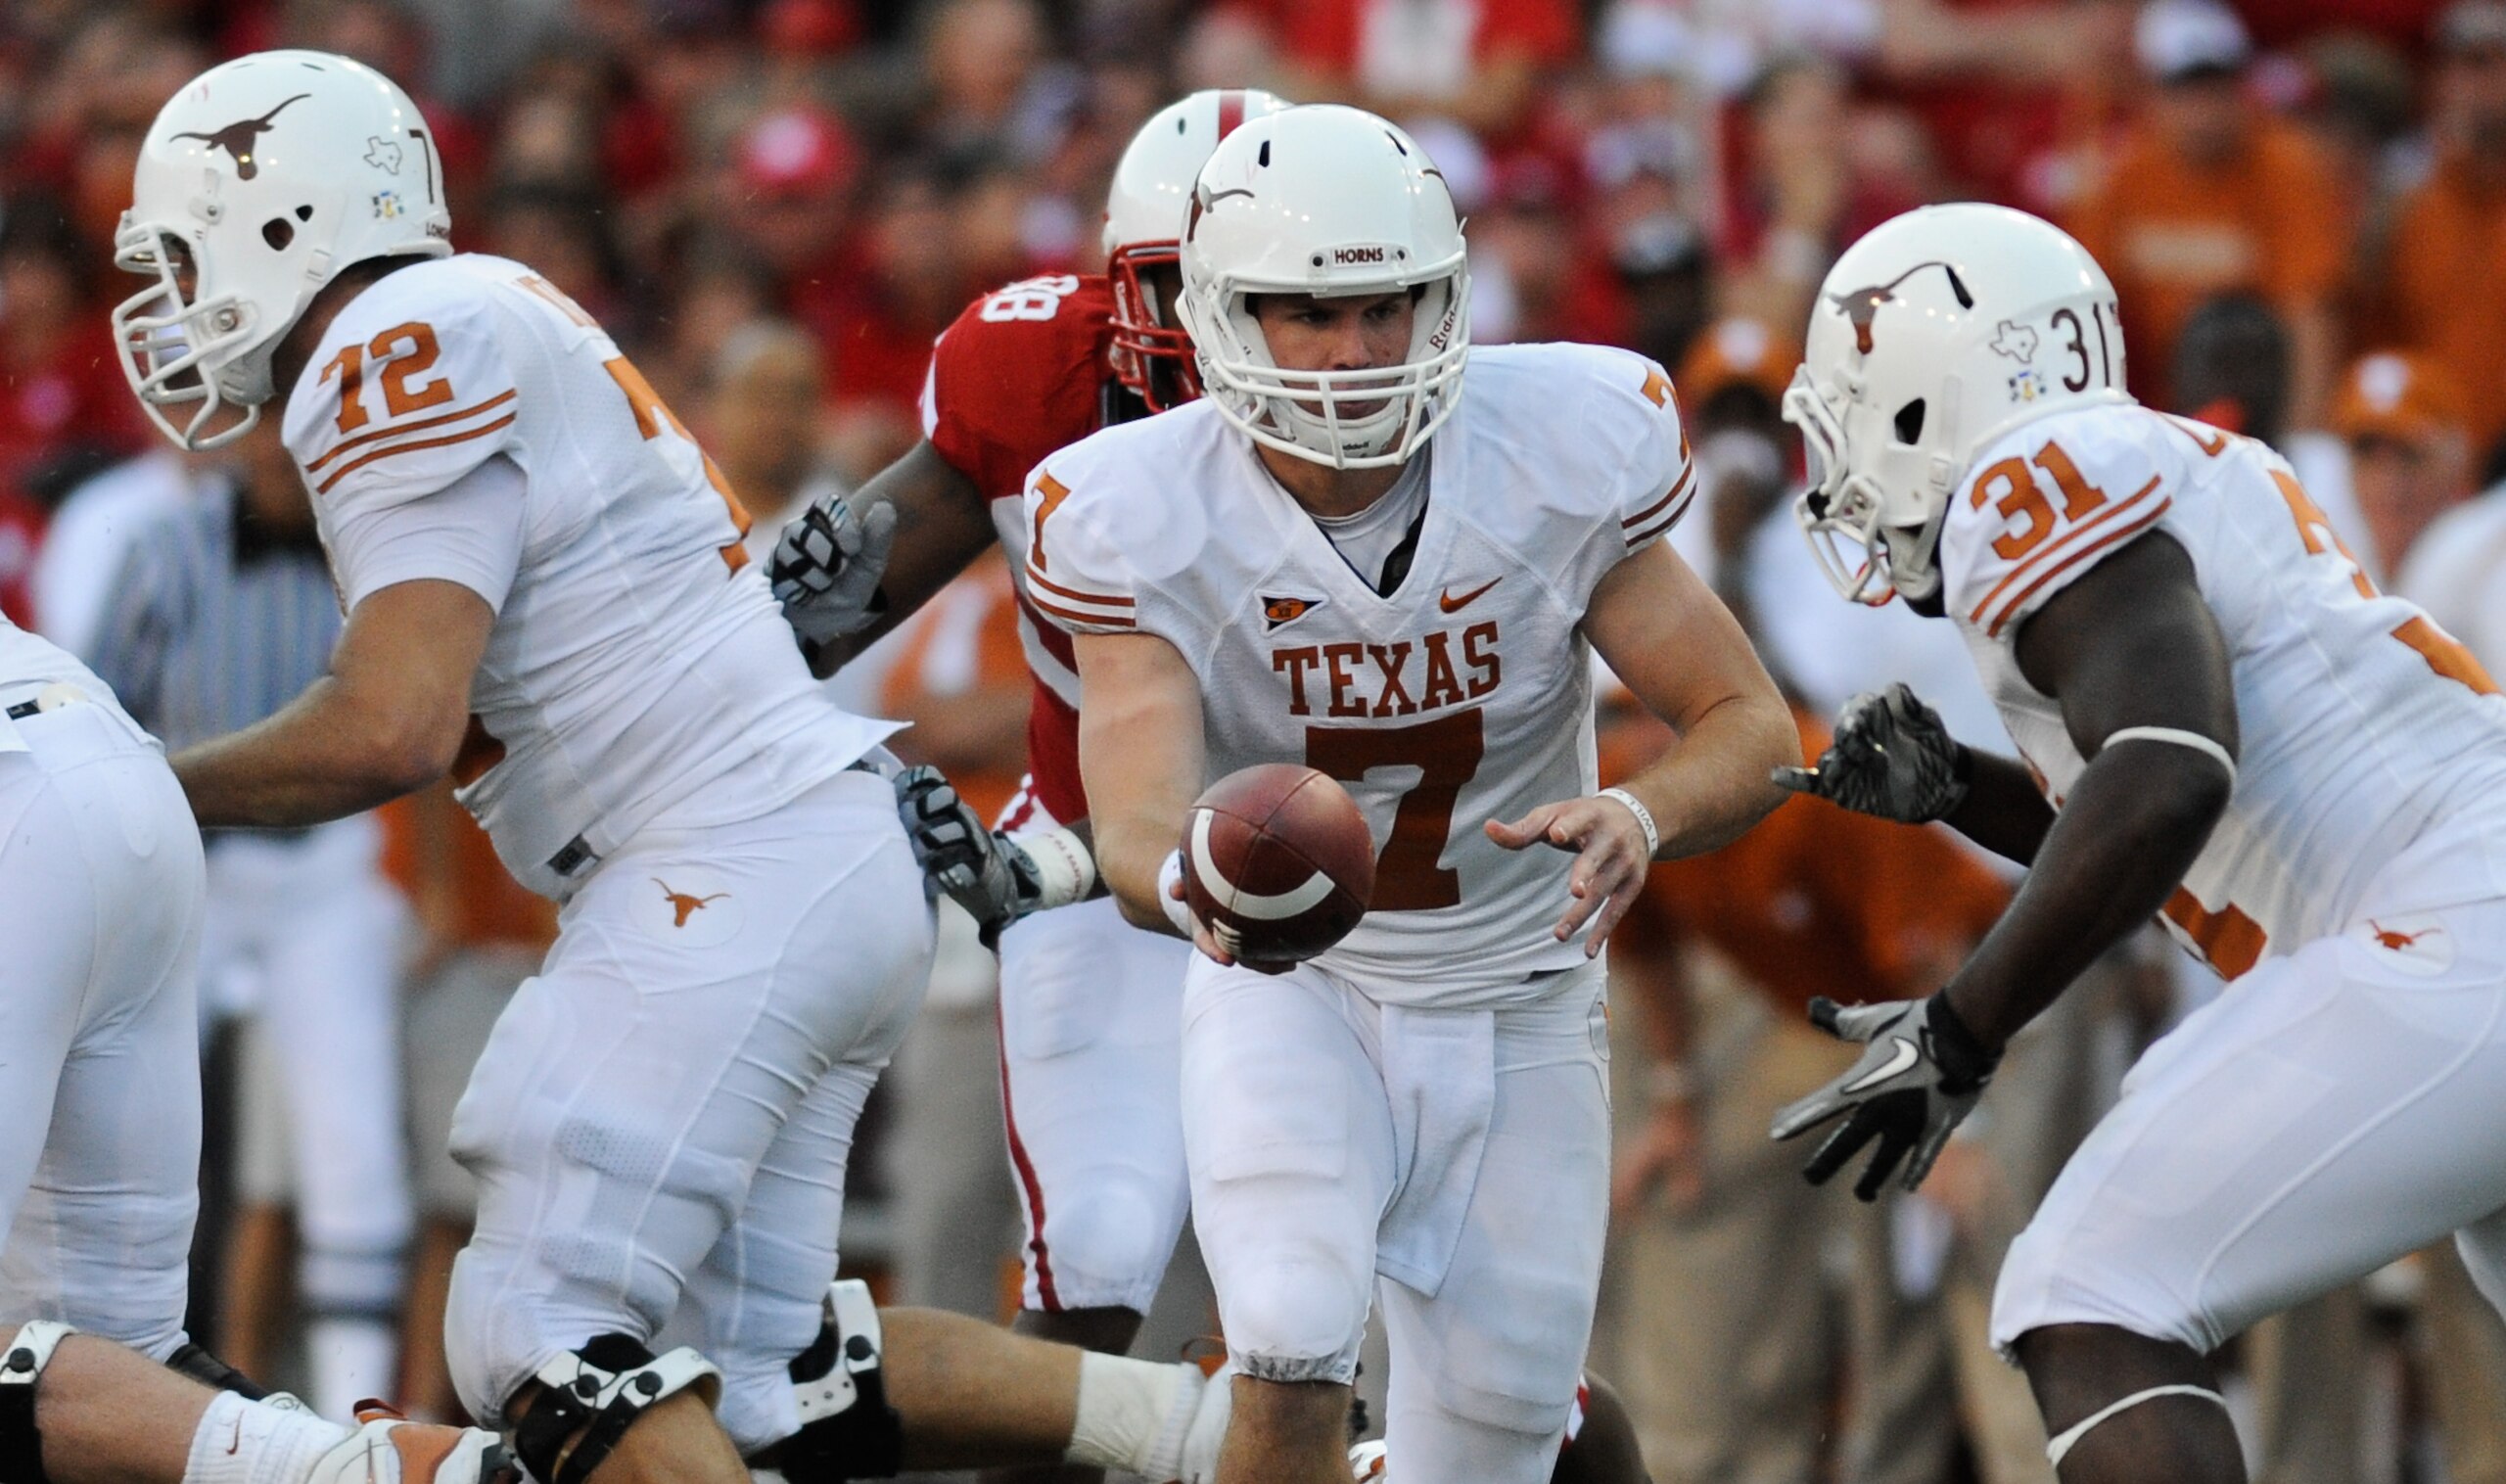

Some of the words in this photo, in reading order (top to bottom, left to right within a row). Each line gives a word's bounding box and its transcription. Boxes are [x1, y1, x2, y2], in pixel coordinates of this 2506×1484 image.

[1334, 247, 1384, 264] HORNS
[317, 320, 455, 435] 72
[2052, 303, 2112, 394] 31
[1032, 468, 1072, 574] 7
[1969, 440, 2109, 561] 31
[1273, 621, 1502, 719] TEXAS
[1305, 706, 1485, 912] 7
